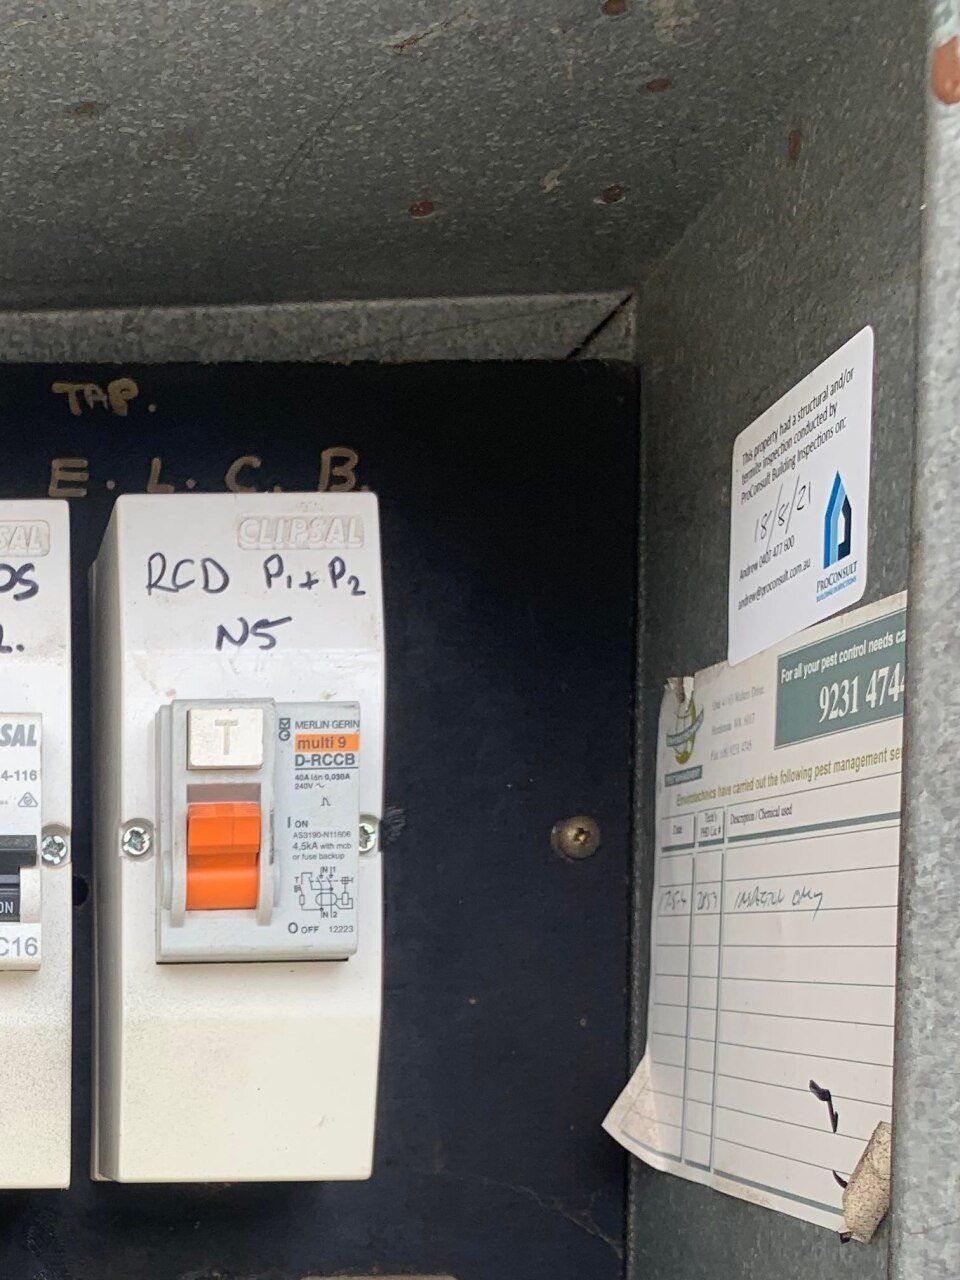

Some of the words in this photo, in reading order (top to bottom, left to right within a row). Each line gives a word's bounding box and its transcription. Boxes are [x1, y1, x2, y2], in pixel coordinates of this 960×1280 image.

[51, 377, 157, 416] TAP.
[742, 447, 753, 466] This
[753, 428, 778, 458] property
[779, 415, 791, 435] had
[796, 386, 828, 421] structural
[829, 364, 854, 397] and/or
[741, 459, 761, 484] termite
[762, 433, 793, 469] inspection
[793, 407, 827, 444] conducted
[828, 401, 837, 420] by
[771, 452, 796, 483] Building
[796, 423, 833, 465] Inspections
[239, 514, 366, 549] CLIPSAL
[146, 552, 230, 595] RCD
[739, 559, 757, 579] Andrew
[771, 541, 783, 558] 477
[215, 616, 292, 651] N5
[781, 669, 793, 684] For
[794, 662, 802, 679] all
[803, 660, 820, 679] your
[821, 651, 838, 673] pest
[839, 640, 866, 663] control
[868, 632, 893, 653] needs
[819, 676, 859, 723] 9231
[214, 719, 239, 756] T
[295, 721, 329, 730] MERLIN
[332, 720, 360, 729] GERIN
[297, 736, 333, 750] multi
[338, 736, 346, 749] 9
[295, 753, 355, 767] D-RCCB
[295, 773, 309, 781] 40A
[756, 776, 766, 789] out
[767, 772, 778, 787] the
[780, 765, 812, 784] following
[815, 760, 831, 780] pest
[833, 747, 888, 773] management
[295, 820, 308, 828] ON
[292, 842, 318, 850] 4.5kA
[320, 842, 334, 850] with
[336, 842, 352, 850] mcb
[301, 853, 317, 861] fuse
[319, 852, 345, 861] backup
[301, 926, 319, 934] OFF
[329, 925, 354, 933] 12223
